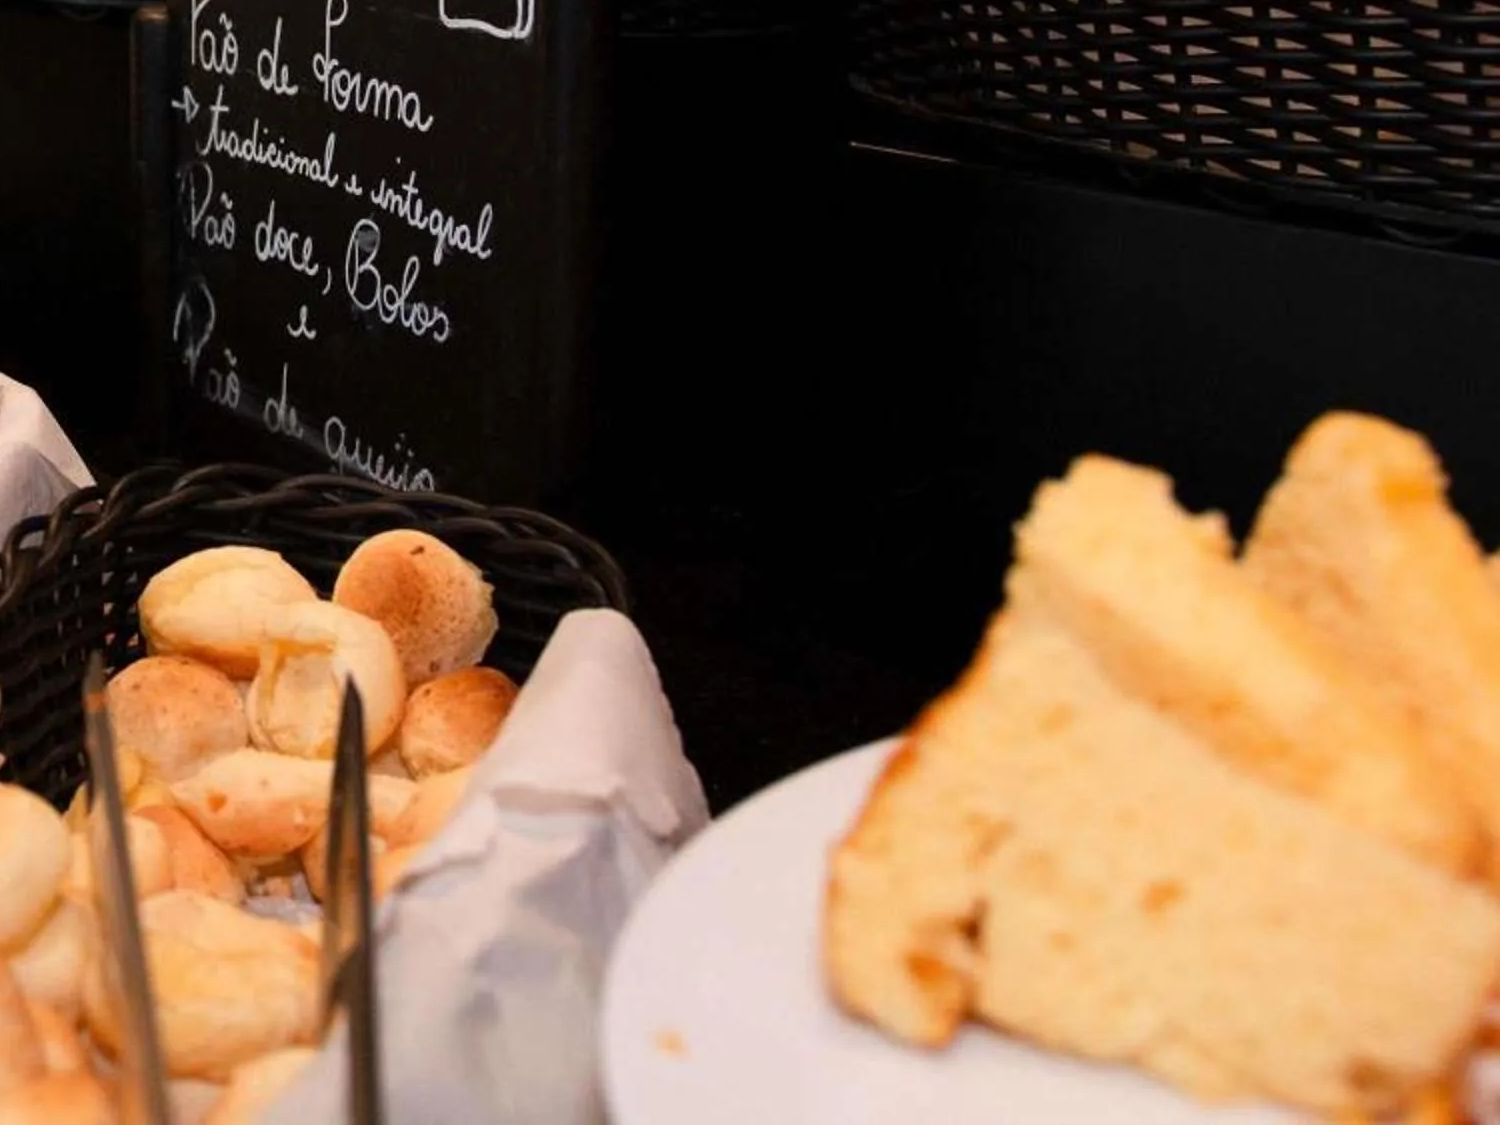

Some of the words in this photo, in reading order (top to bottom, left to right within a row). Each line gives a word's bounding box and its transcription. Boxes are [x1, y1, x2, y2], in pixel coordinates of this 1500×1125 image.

[257, 16, 299, 96] de
[200, 85, 338, 187] tradicional
[345, 174, 363, 196] e
[371, 157, 494, 266] integral
[345, 219, 450, 342] Bolos
[287, 305, 317, 340] e
[263, 363, 303, 440] de
